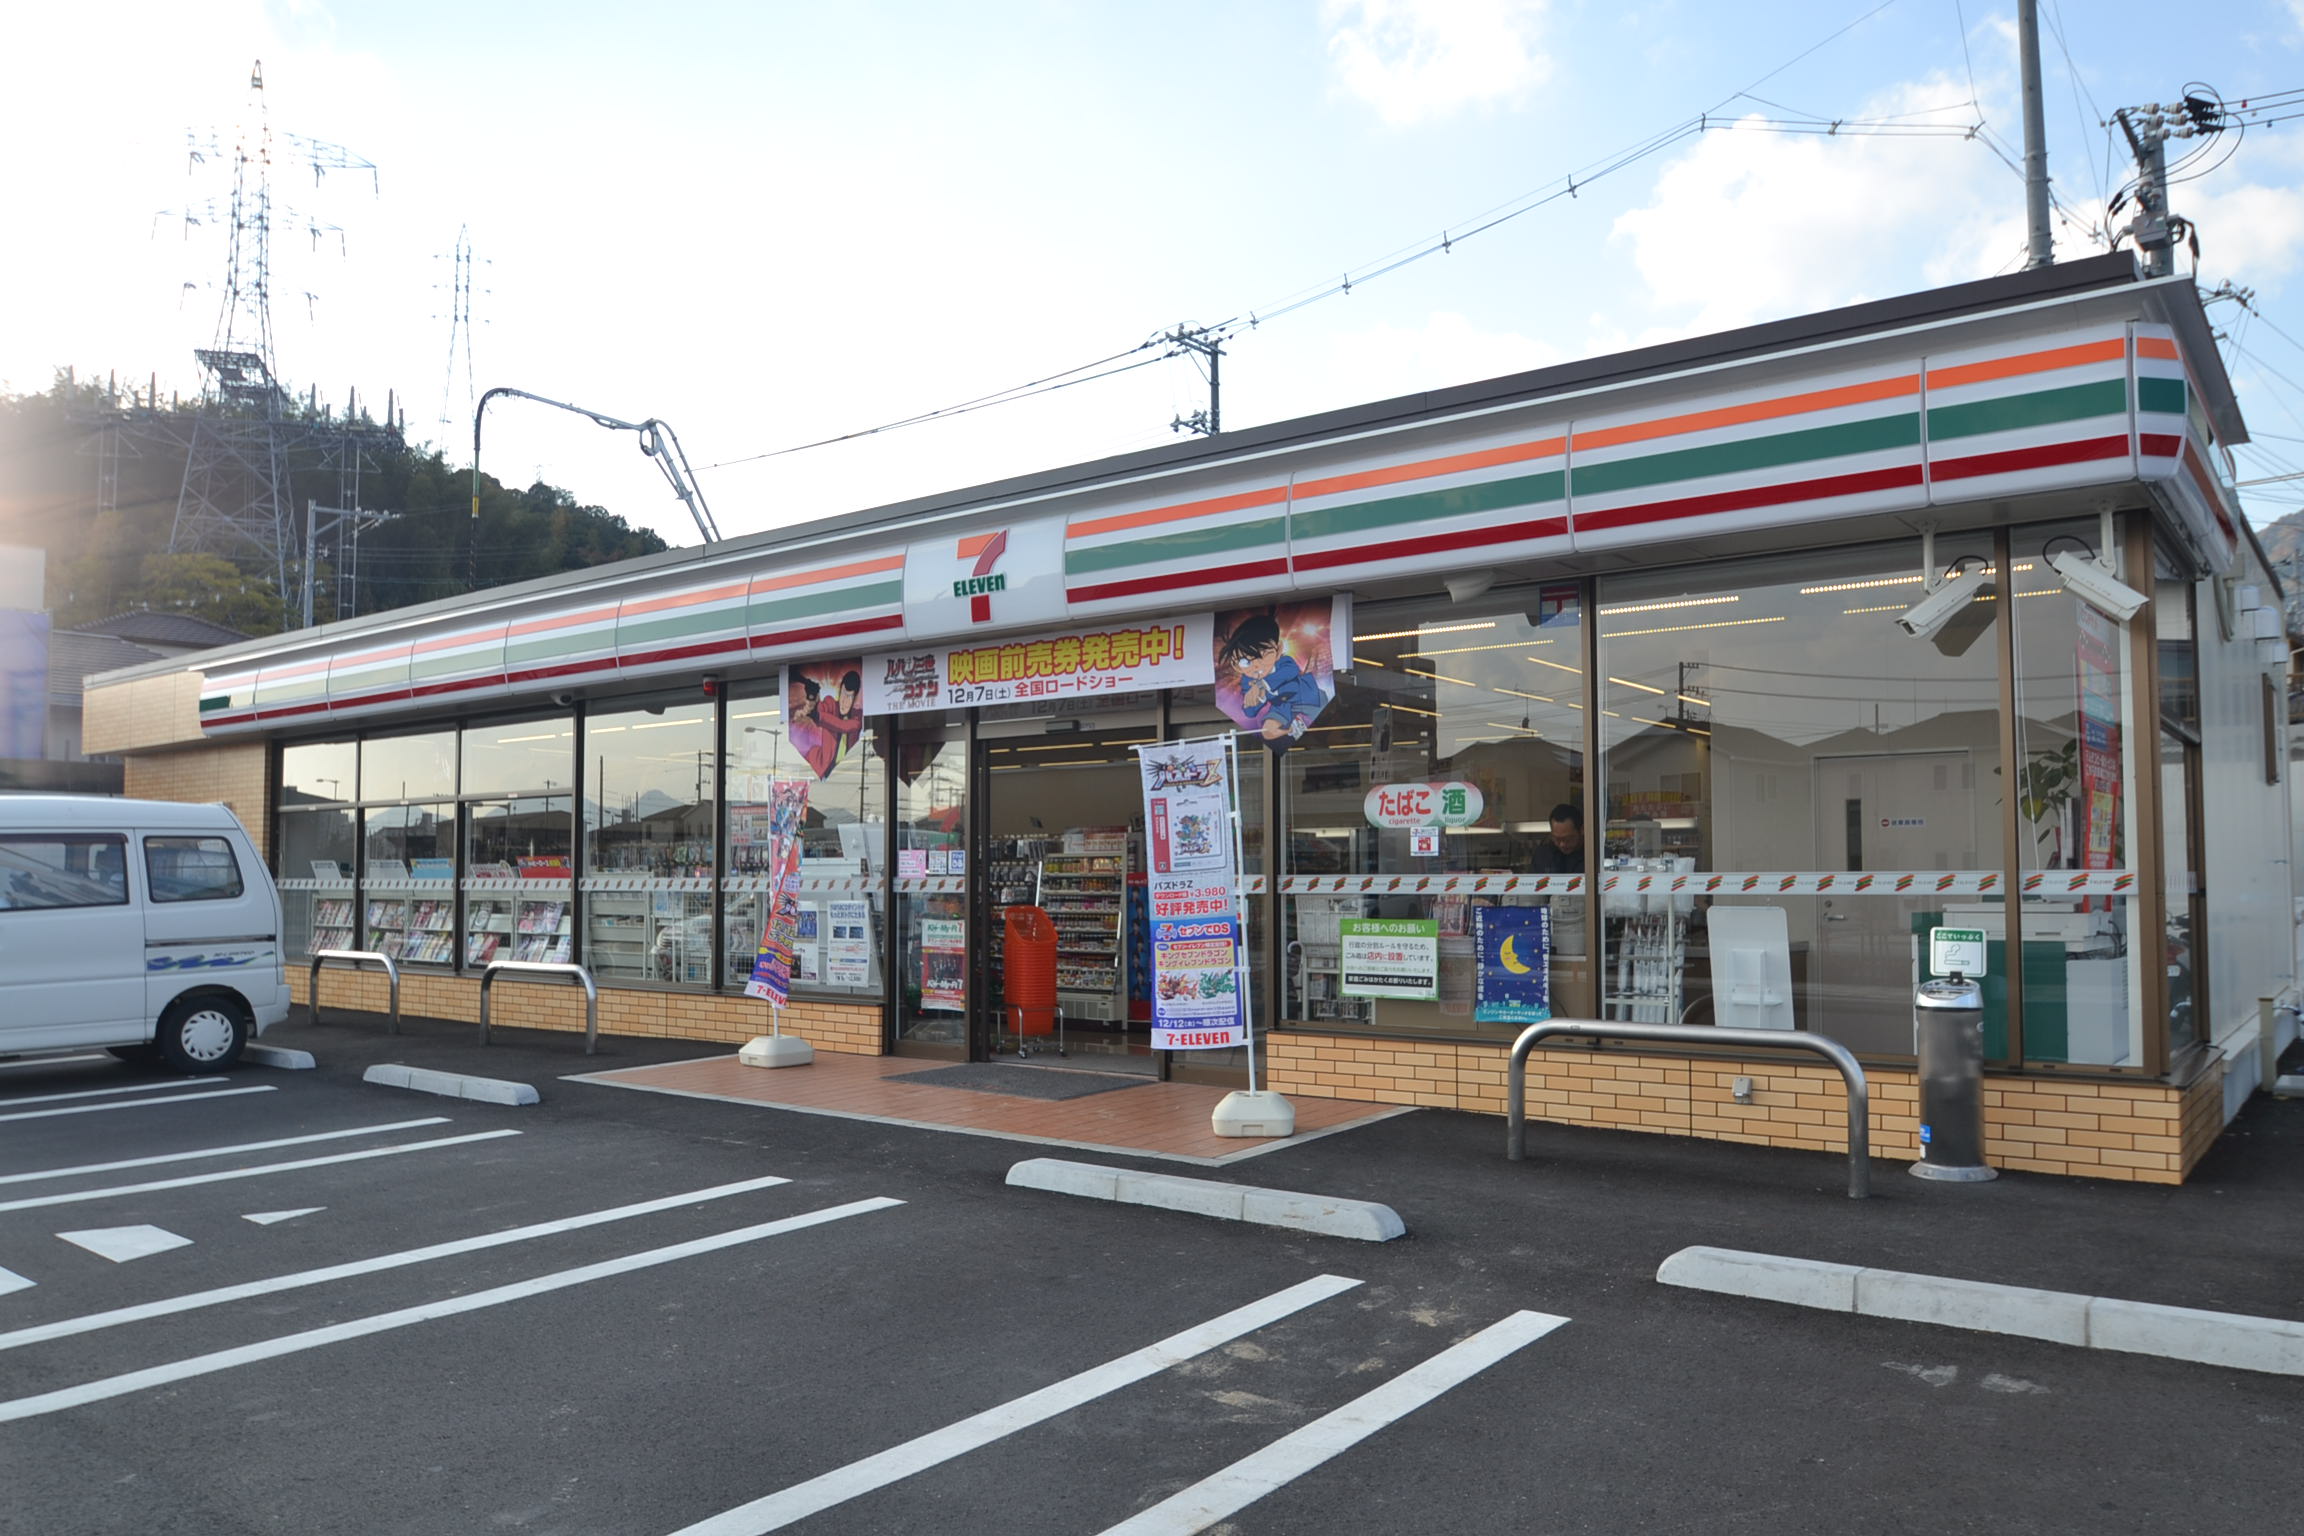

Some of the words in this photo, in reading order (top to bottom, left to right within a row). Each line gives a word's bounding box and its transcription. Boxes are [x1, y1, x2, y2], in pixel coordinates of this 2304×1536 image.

[947, 625, 1185, 687] 映画前売券発売中!
[948, 686, 1011, 704] 12月7日(土)
[1014, 675, 1134, 698] 全国ロードショー
[1379, 788, 1431, 816] たばこ
[1442, 789, 1466, 814] 酒
[1388, 817, 1421, 825] cigarette
[1444, 816, 1465, 824] liquor
[1155, 898, 1229, 917] 好評発売中!
[1353, 923, 1426, 934] お客様へのお願い
